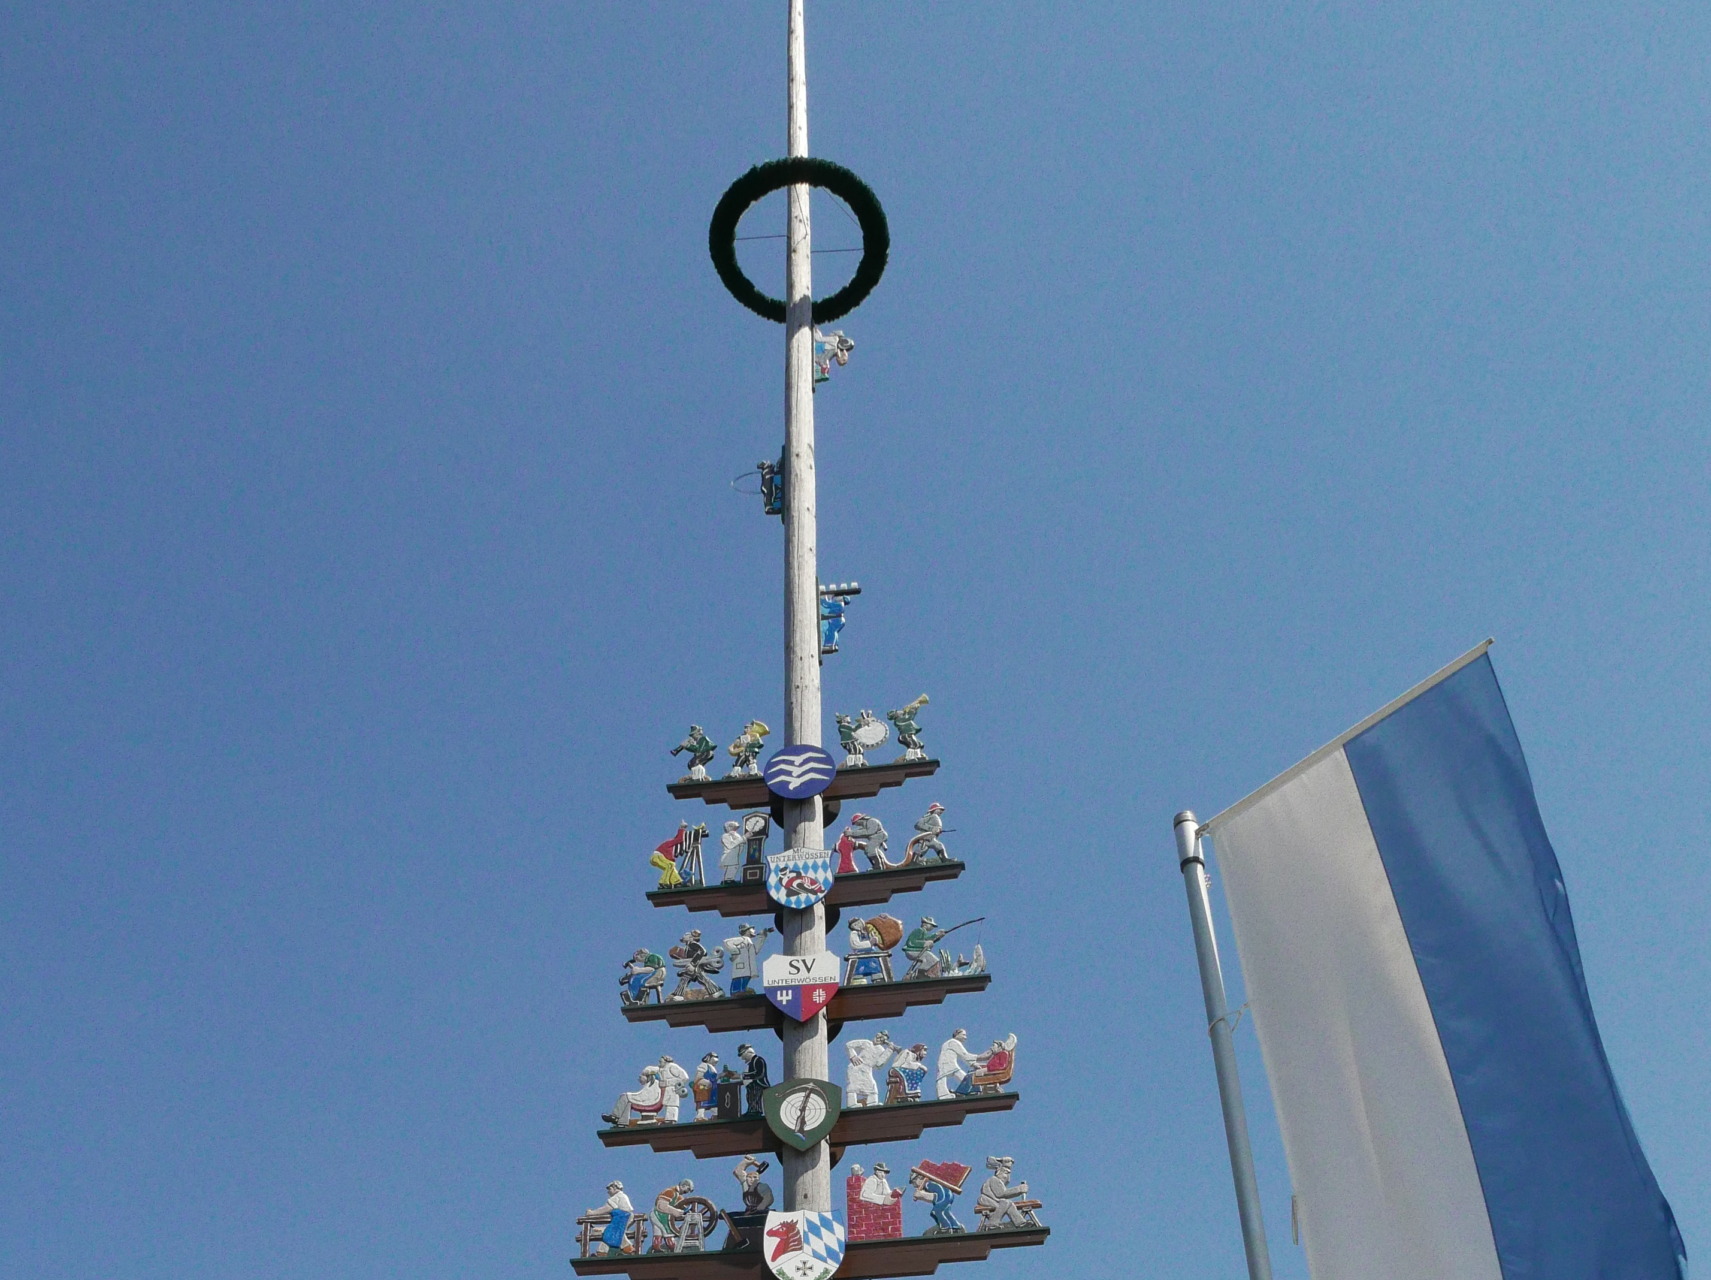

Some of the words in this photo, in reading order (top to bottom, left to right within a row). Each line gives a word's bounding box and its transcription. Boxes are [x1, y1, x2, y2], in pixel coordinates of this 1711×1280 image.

[770, 851, 829, 863] UNTERWÖSSEN
[788, 958, 816, 975] SV
[767, 976, 837, 986] UNTERWÖSSEN
